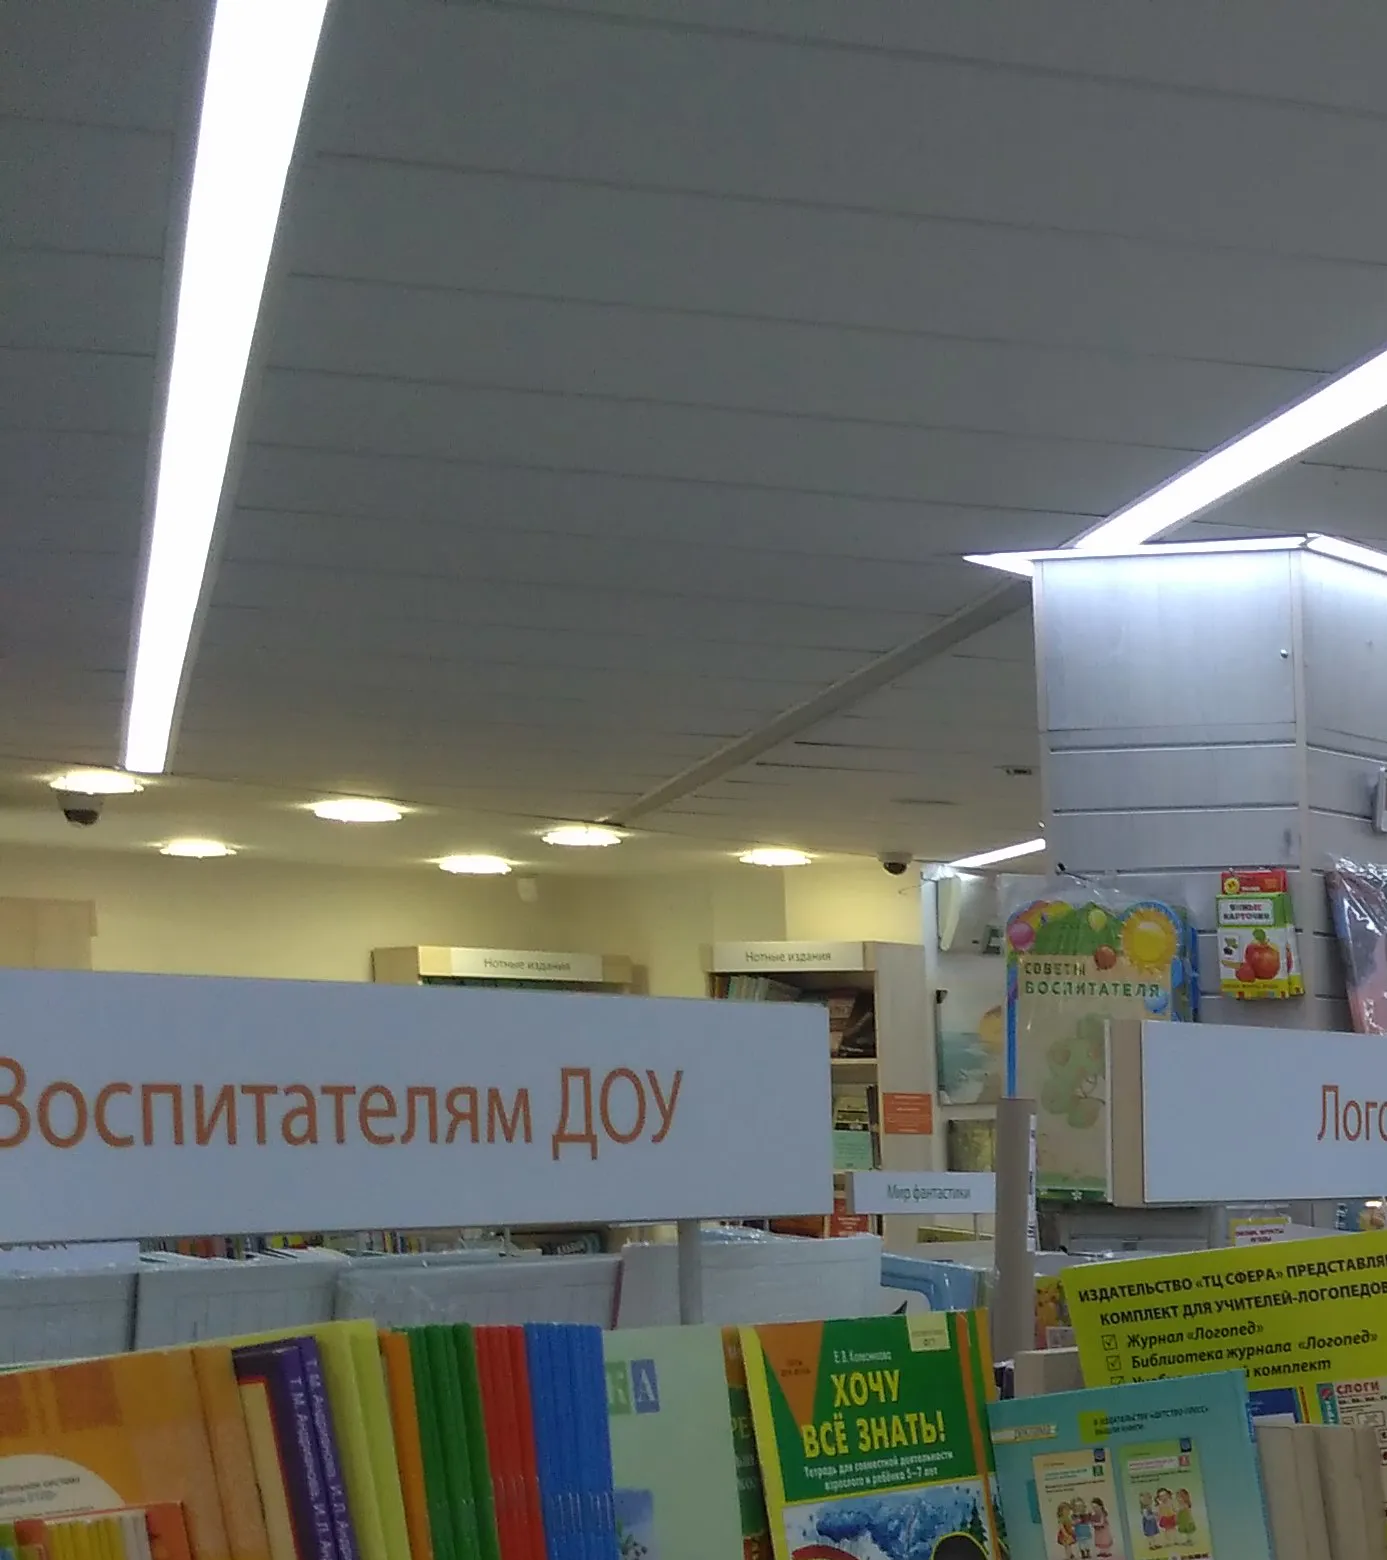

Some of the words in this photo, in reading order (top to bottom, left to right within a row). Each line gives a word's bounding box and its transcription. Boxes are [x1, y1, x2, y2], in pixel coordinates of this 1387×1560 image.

[745, 950, 783, 963] Нотные
[787, 950, 831, 965] издания
[1025, 979, 1161, 998] ВОСПИТАТЕЛЯ
[552, 1066, 684, 1161] ДОУ
[913, 1183, 971, 1202] фантастики
[1078, 1277, 1192, 1303] ИЗДАТЕЛЬСТВО
[1225, 1268, 1284, 1287] СФЕРА»
[1100, 1305, 1179, 1327] КОМПЛЕКТ
[1182, 1302, 1214, 1320] ДЛЯ
[1127, 1331, 1184, 1350] Журнал
[1187, 1322, 1264, 1344] «Логопед»
[1132, 1348, 1223, 1370] Библиотека
[1226, 1341, 1292, 1361] журнала
[1298, 1329, 1379, 1352] «Логопед»
[1252, 1358, 1332, 1377] комплект
[830, 1369, 900, 1408] ХОЧУ
[1335, 1380, 1380, 1397] СЛОГИ
[802, 1412, 849, 1458] ВСЁ
[856, 1410, 946, 1452] ЗНАТЬ!
[804, 1464, 837, 1480] Тетрадь
